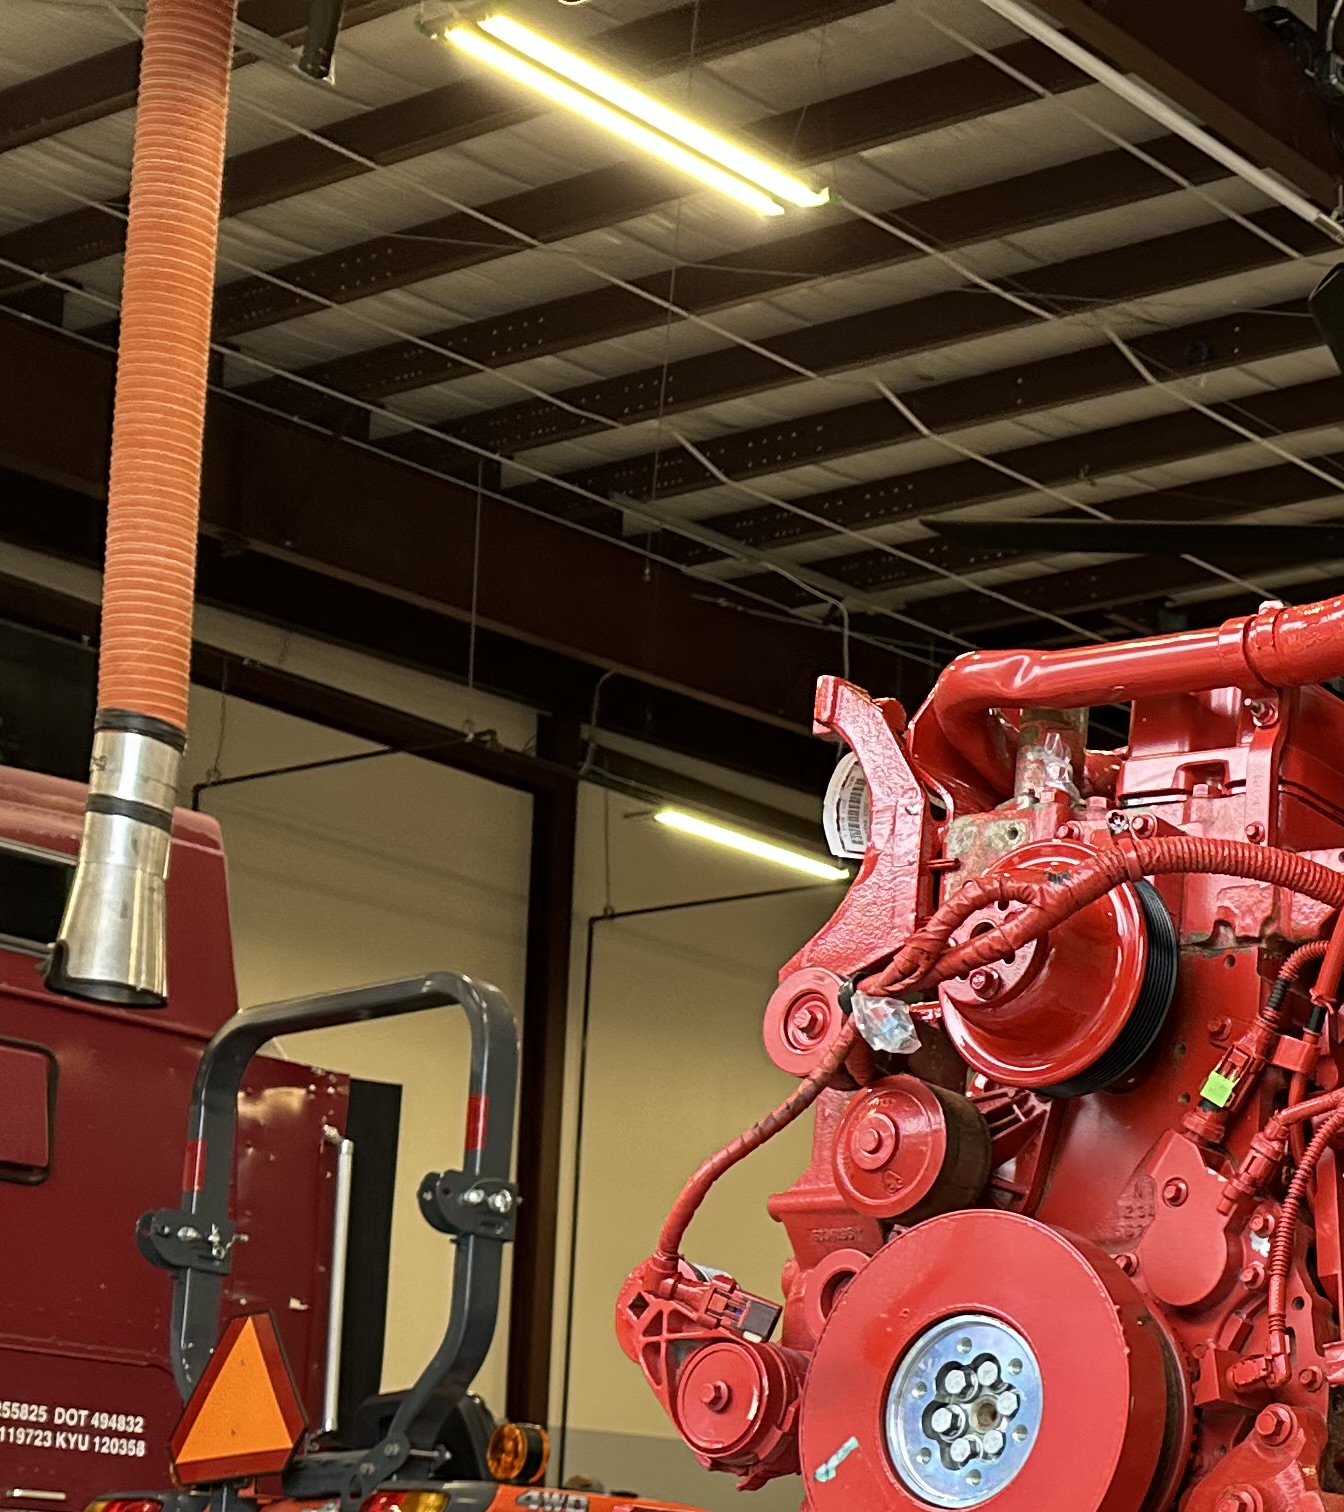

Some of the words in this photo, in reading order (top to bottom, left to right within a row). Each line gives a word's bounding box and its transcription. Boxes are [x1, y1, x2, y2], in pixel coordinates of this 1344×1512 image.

[54, 1406, 89, 1427] DOT
[90, 1412, 144, 1434] 494832
[55, 1431, 89, 1451] KYU
[93, 1436, 146, 1457] 120358
